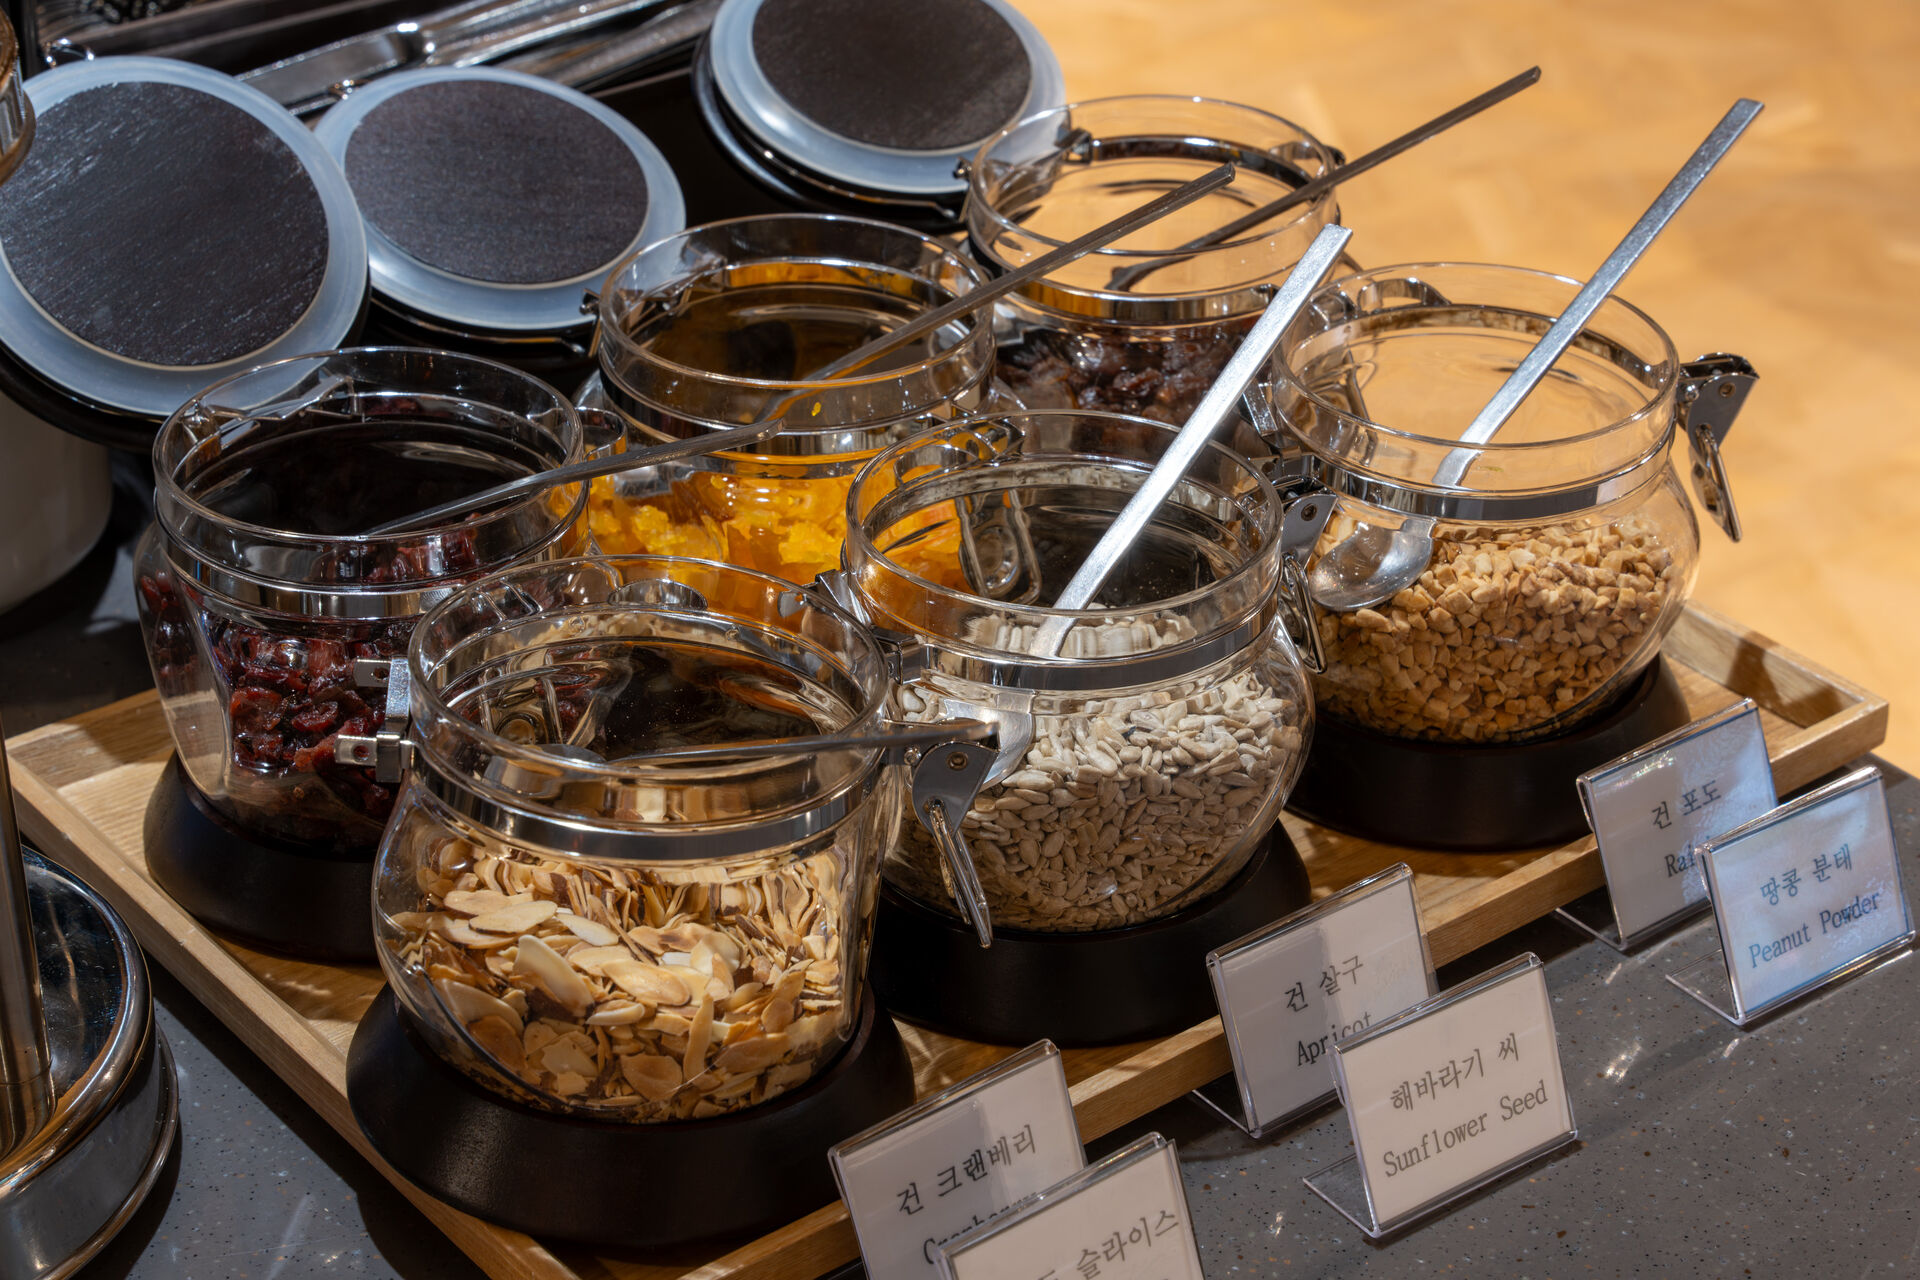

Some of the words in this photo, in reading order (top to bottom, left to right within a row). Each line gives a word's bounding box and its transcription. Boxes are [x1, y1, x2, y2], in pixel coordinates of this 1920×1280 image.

[1652, 801, 1672, 829] 건
[1682, 780, 1721, 816] 포도
[1760, 868, 1801, 906] 땅콩
[1812, 843, 1852, 882] 분태
[1749, 922, 1811, 968] Peanut
[1819, 892, 1880, 934] Powder
[1285, 982, 1308, 1012] 건
[1319, 955, 1363, 996] 살구
[1298, 1011, 1371, 1066] Apricot
[1390, 1048, 1484, 1110] 해바라기
[1498, 1032, 1519, 1061] 씨
[1383, 1113, 1488, 1177] Sunflower
[1500, 1079, 1548, 1121] Seed
[897, 1182, 924, 1215] 건
[937, 1124, 1036, 1197] 크랜베리
[1077, 1210, 1179, 1280] 슬라이스
